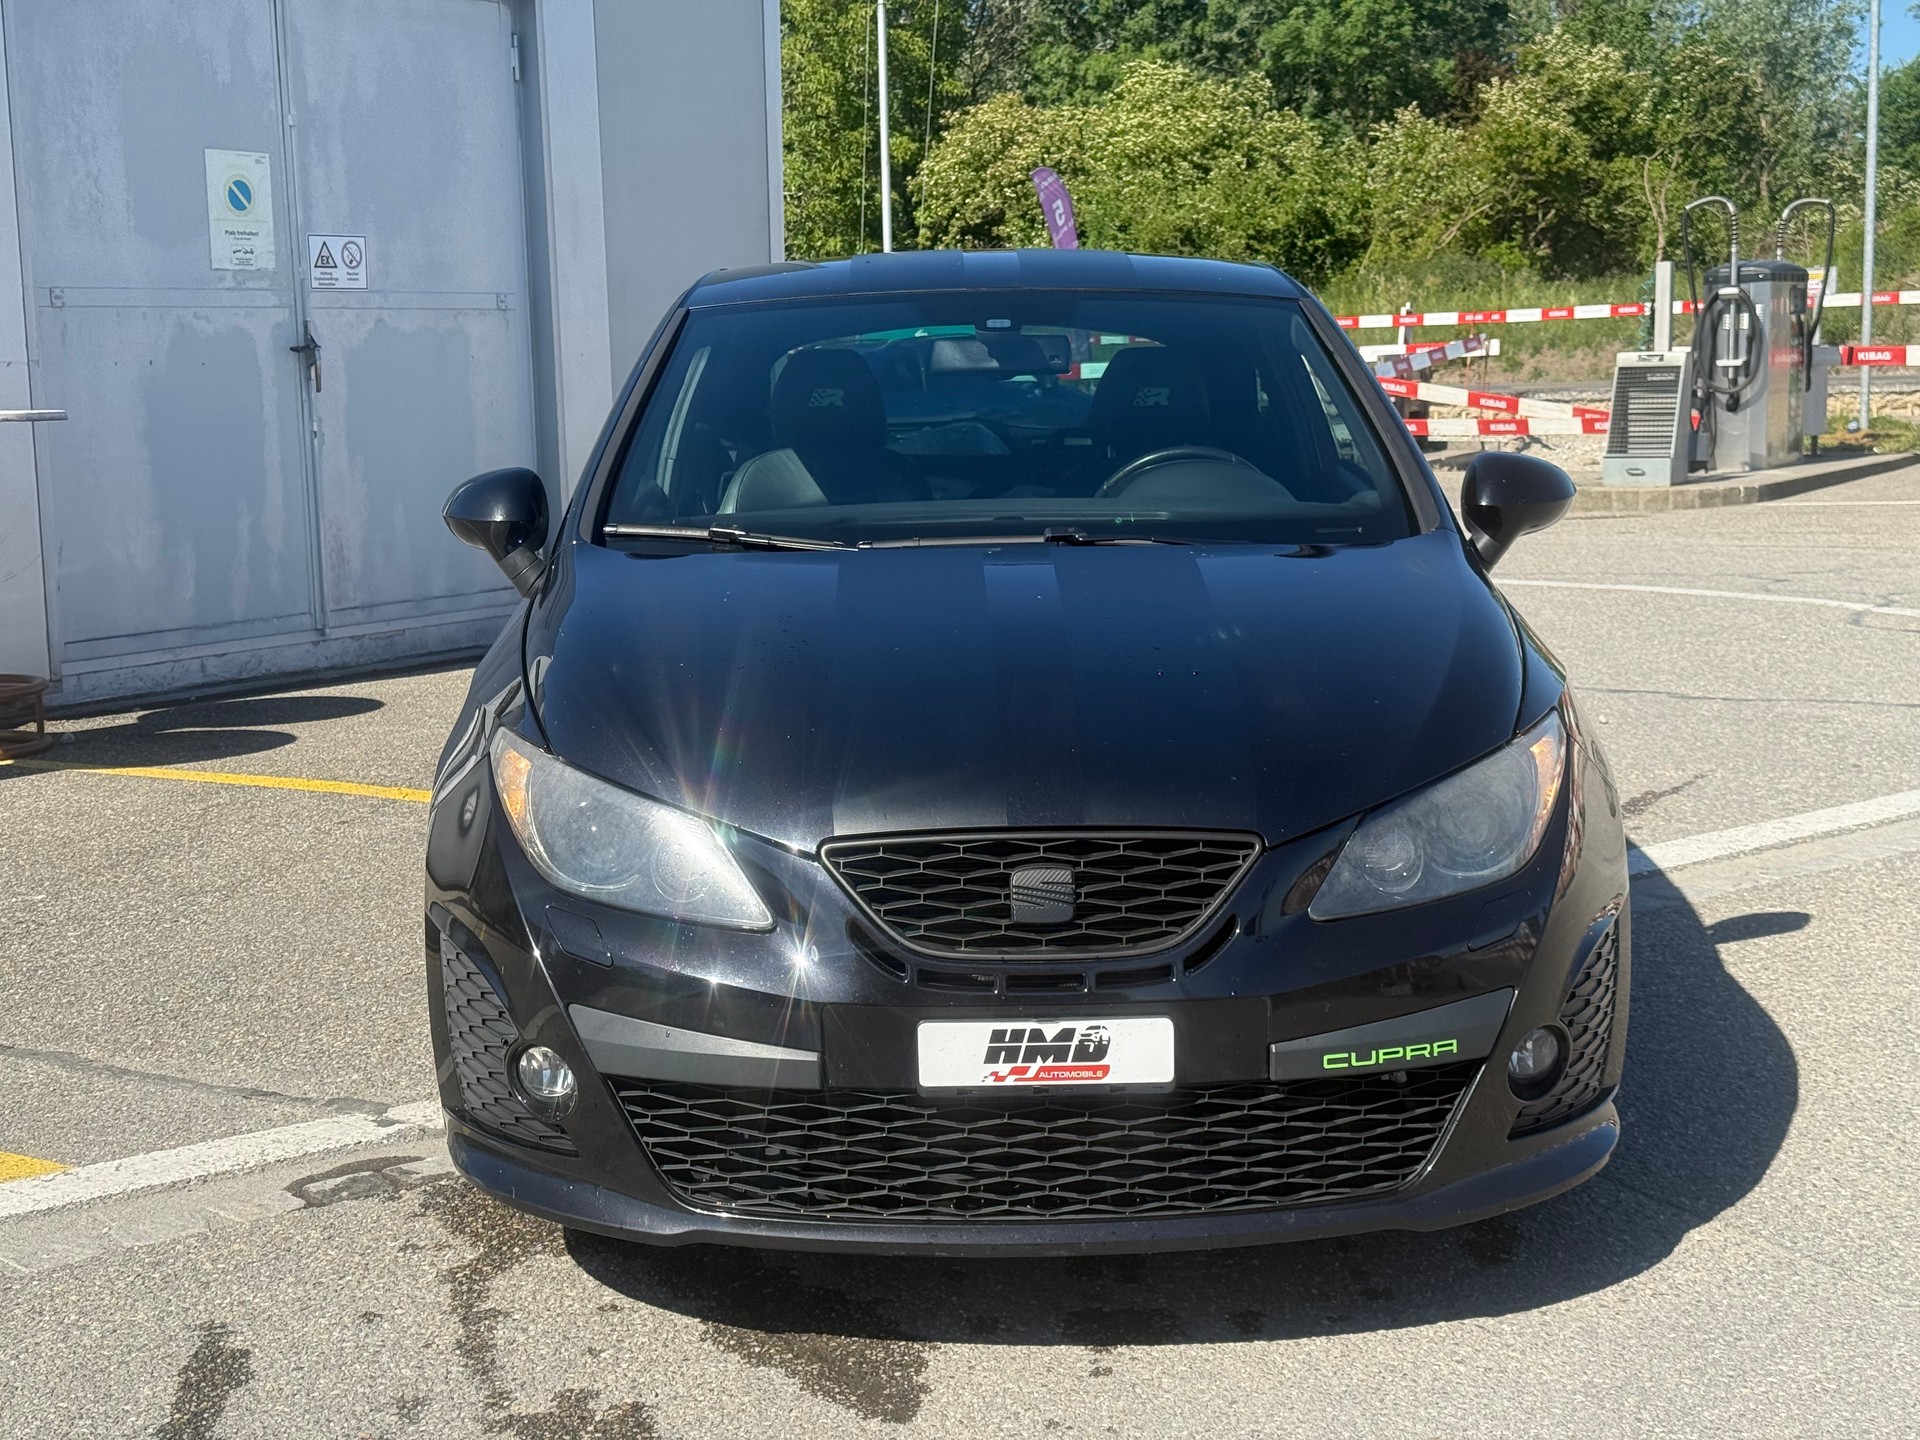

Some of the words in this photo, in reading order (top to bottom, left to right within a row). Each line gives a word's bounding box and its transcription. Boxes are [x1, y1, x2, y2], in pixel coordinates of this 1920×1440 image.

[320, 255, 330, 265] EX
[1857, 351, 1892, 361] KIBAG
[1479, 397, 1507, 410] KIBAG
[1489, 422, 1518, 432] KIBAG
[1322, 1038, 1458, 1070] CUPRA
[1038, 1070, 1103, 1079] AUTOMOBILE
